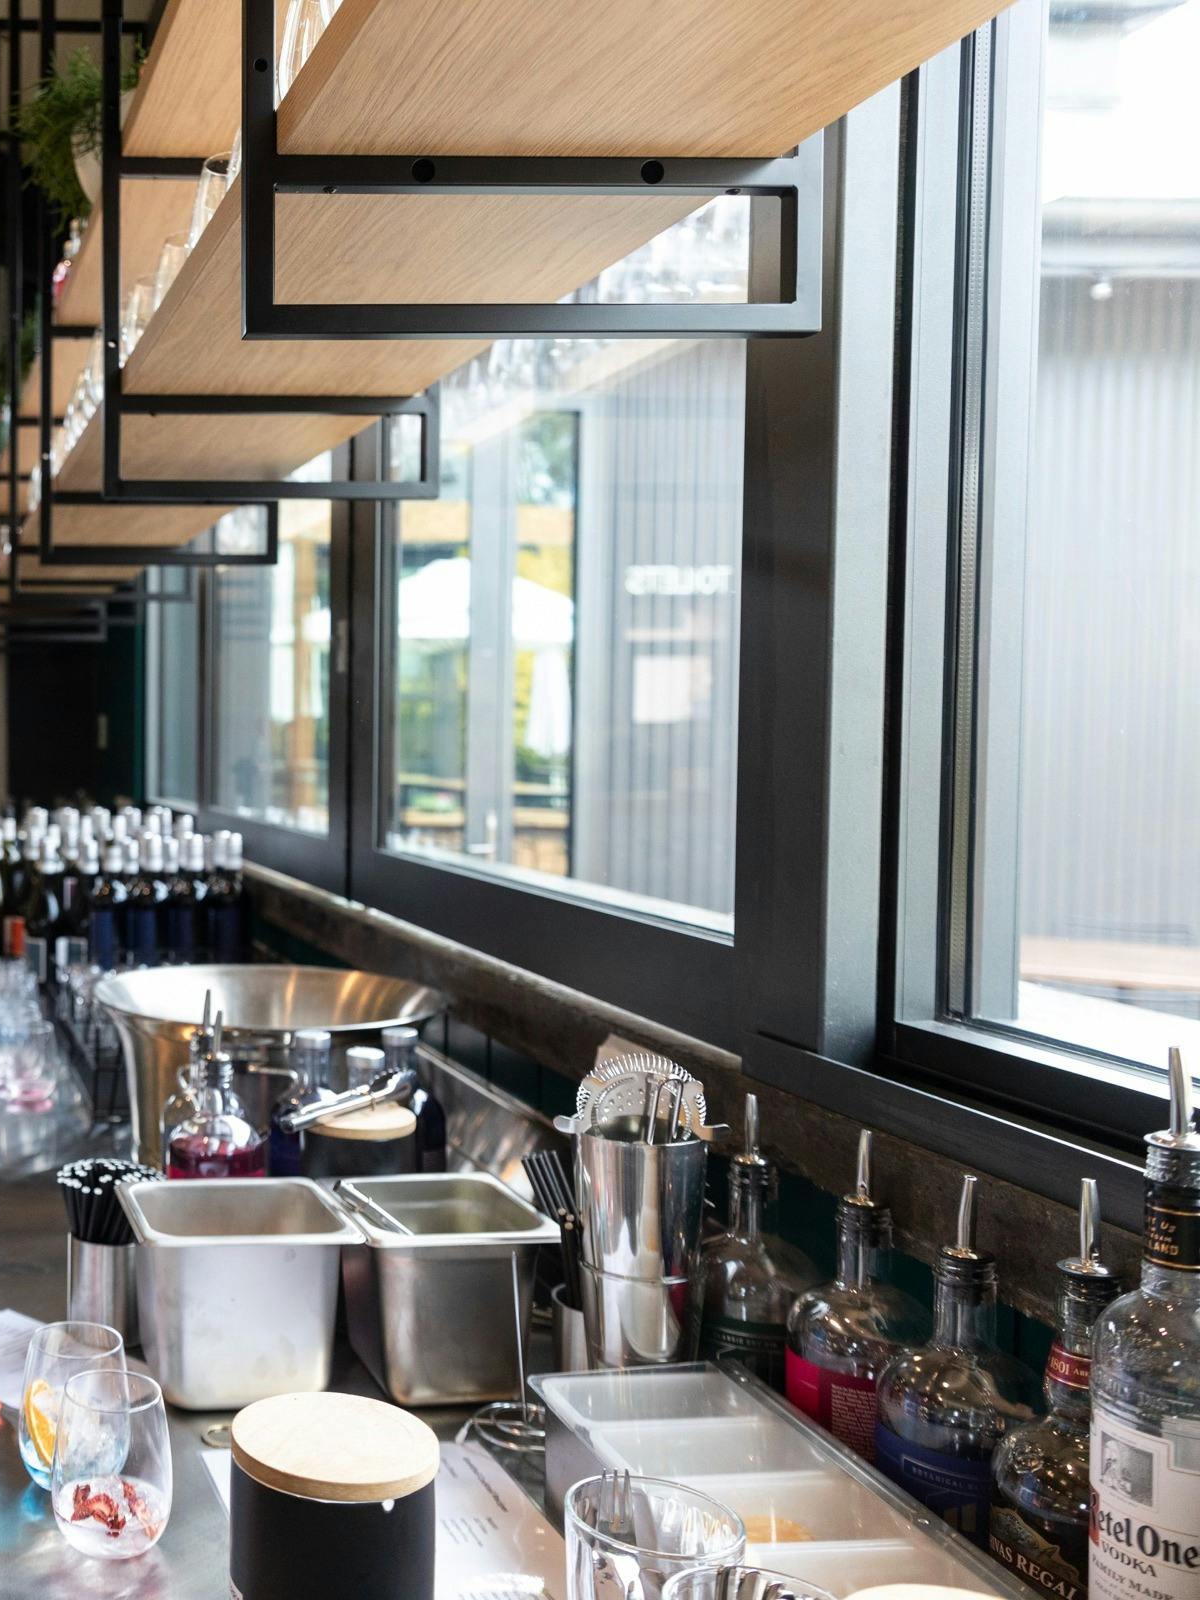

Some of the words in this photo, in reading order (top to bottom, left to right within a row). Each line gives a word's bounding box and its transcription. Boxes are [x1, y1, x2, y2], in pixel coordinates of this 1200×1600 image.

[1147, 1240, 1179, 1257] LAND
[1050, 1356, 1070, 1376] 1801
[1101, 1540, 1157, 1578] VODKA
[1136, 1525, 1200, 1569] One
